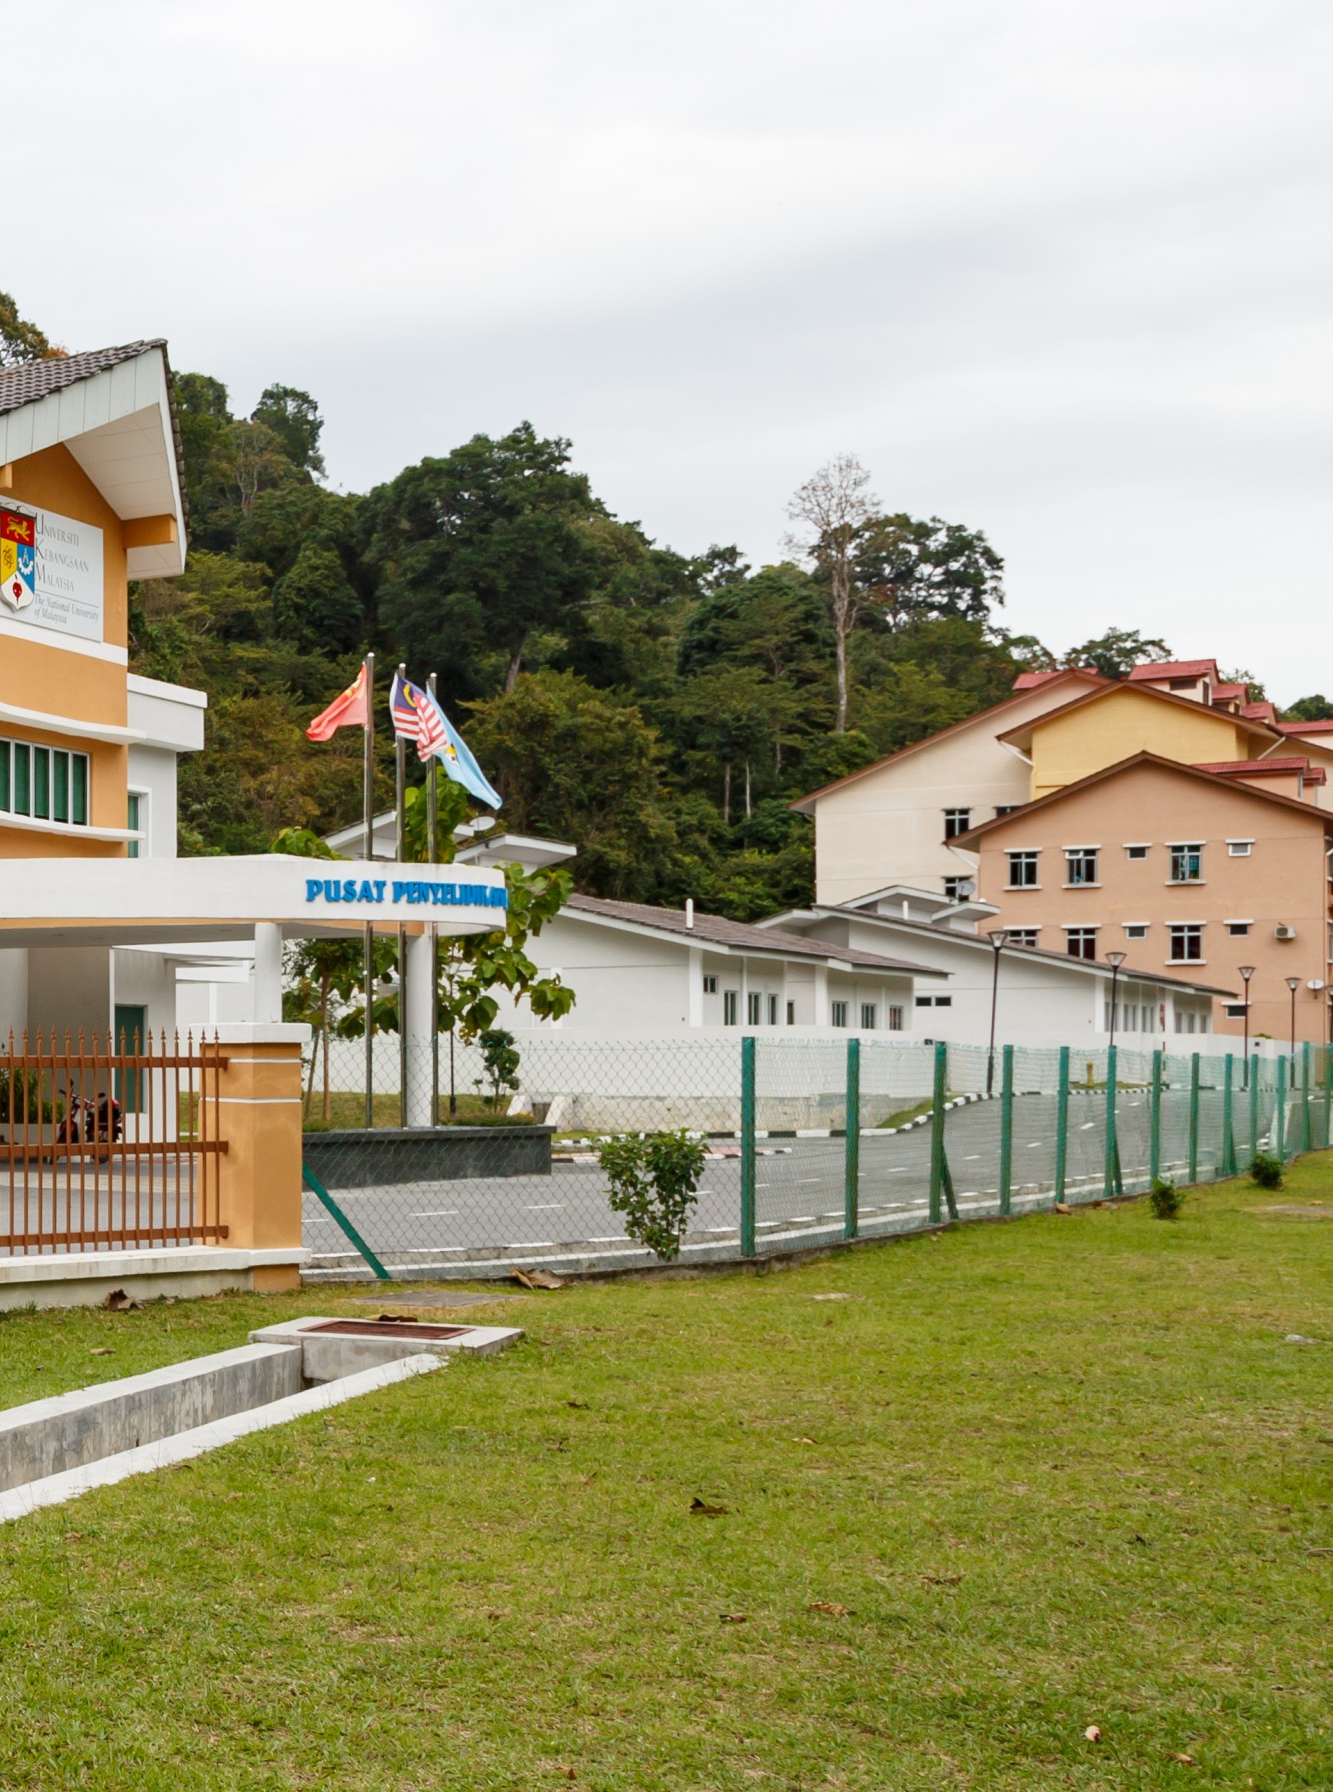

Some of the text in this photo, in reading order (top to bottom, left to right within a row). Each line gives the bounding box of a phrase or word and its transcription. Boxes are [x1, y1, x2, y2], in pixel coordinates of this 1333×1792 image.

[35, 512, 79, 547] UNIVERSITI
[35, 537, 89, 573] KEBANGSAAN
[35, 562, 75, 592] MALAYSIA
[306, 879, 386, 902] PUSAT
